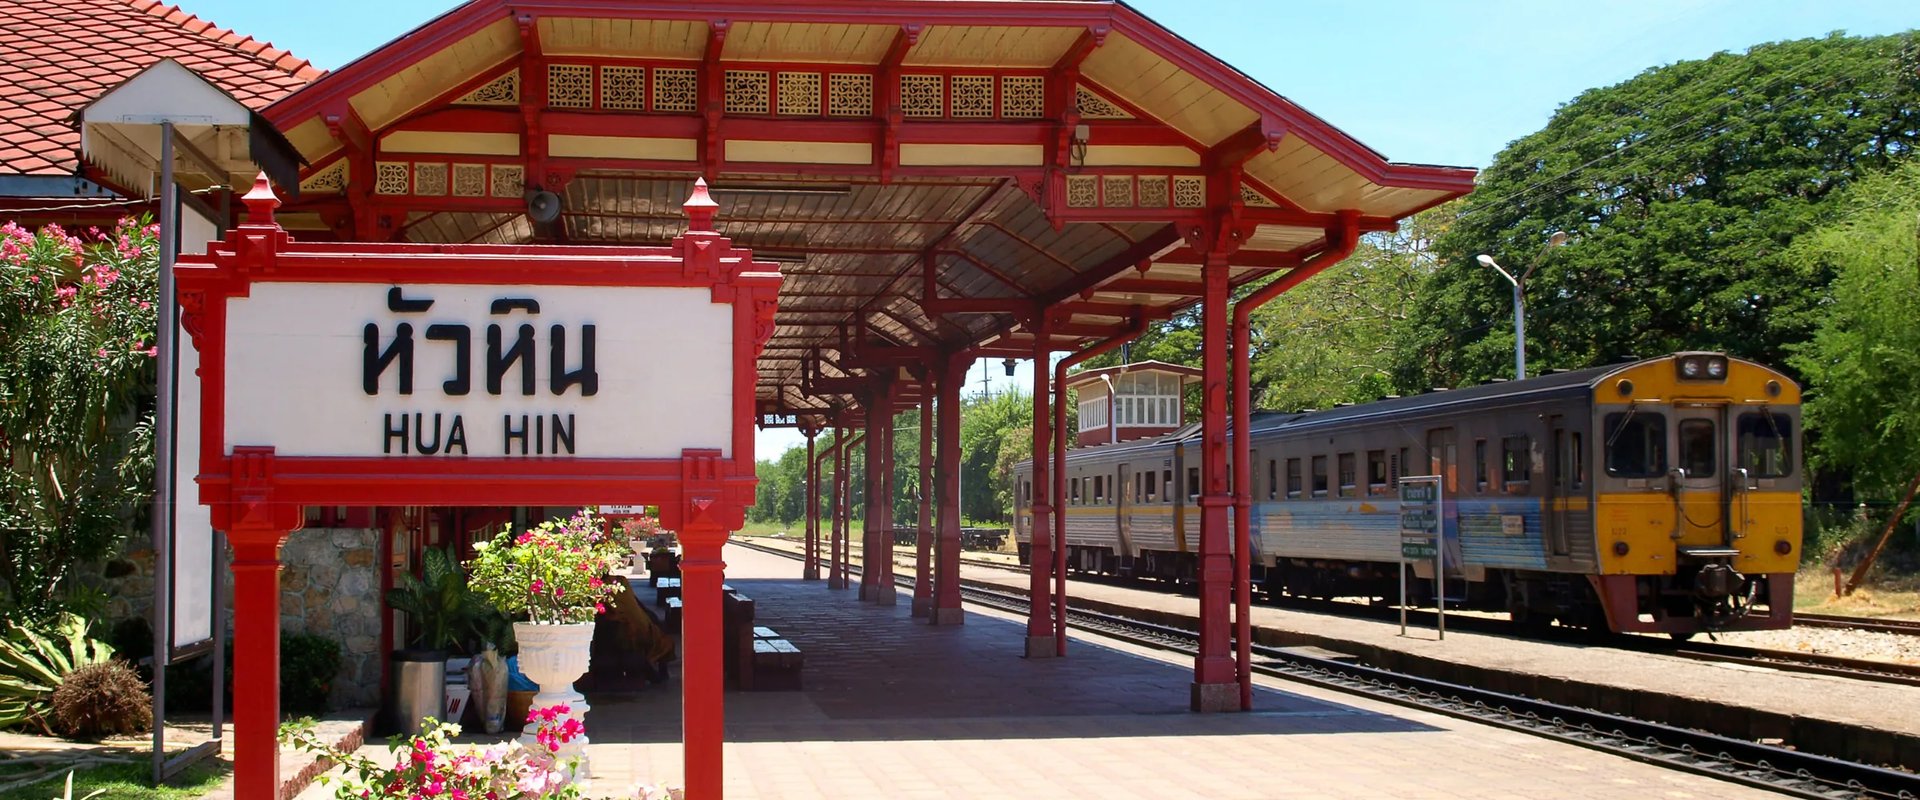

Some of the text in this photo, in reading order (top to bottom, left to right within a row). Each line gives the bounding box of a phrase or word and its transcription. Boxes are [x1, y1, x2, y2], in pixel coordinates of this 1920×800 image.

[363, 287, 598, 396] หัวหิน
[384, 413, 575, 455] HUA HIN
